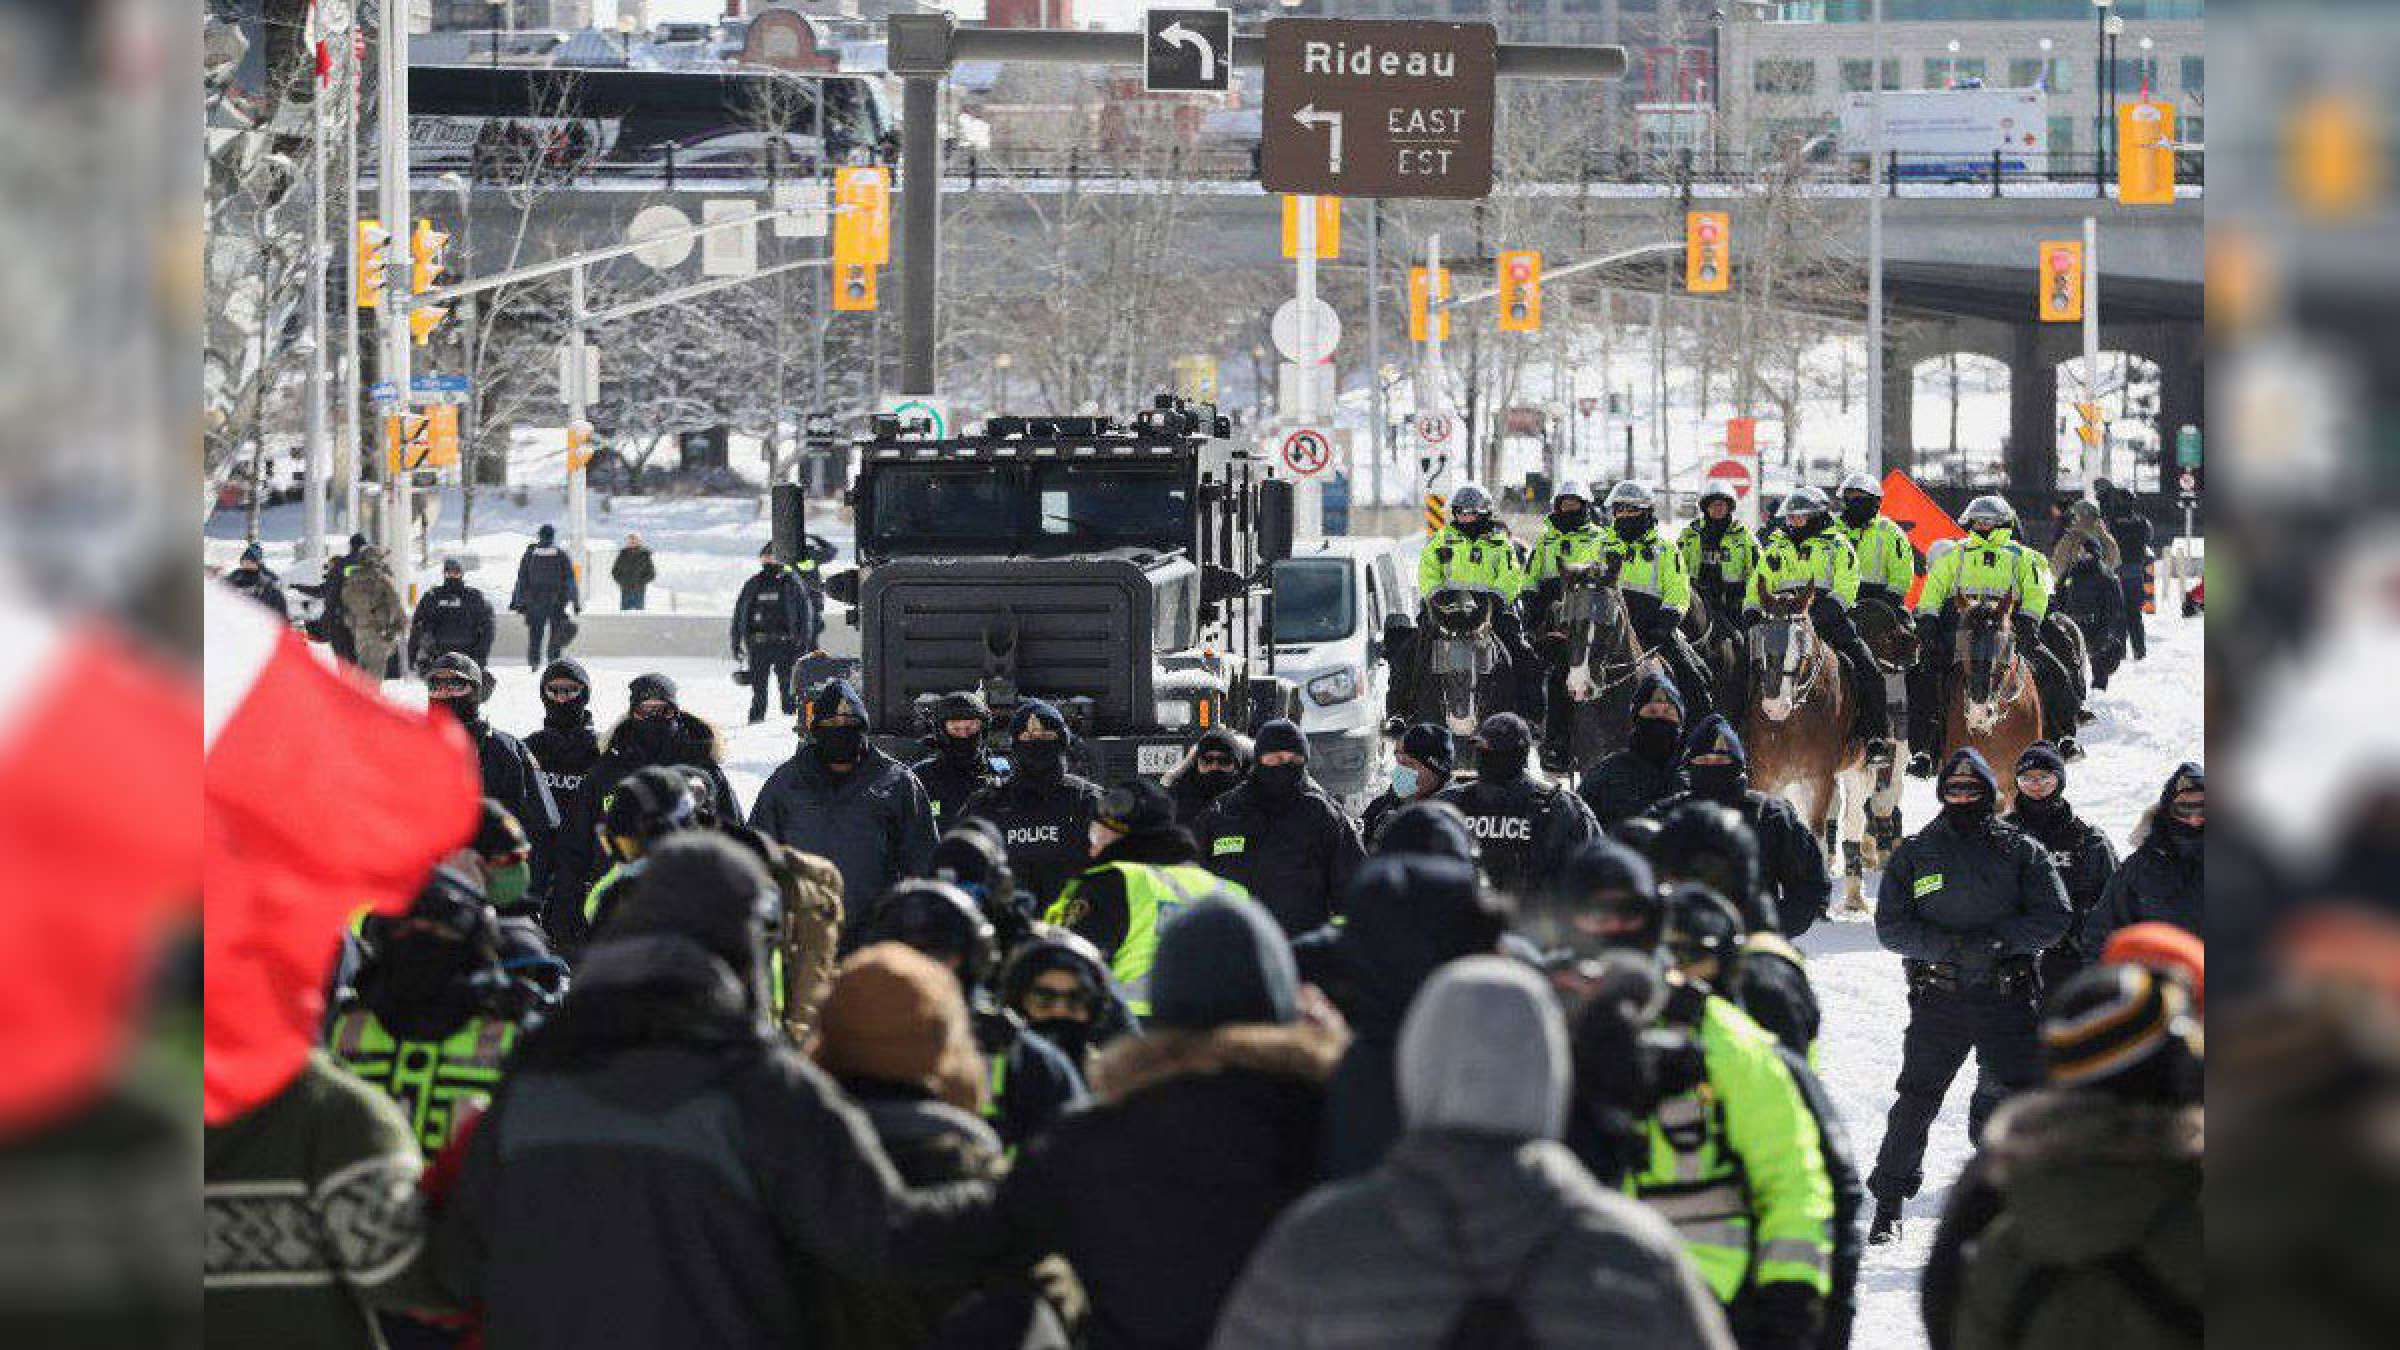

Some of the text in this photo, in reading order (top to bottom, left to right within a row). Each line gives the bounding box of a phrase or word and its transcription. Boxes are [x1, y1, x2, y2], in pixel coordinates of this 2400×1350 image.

[1304, 42, 1455, 76] Rideau
[1388, 107, 1464, 132] EAST
[1400, 150, 1452, 174] EST
[1007, 826, 1059, 844] POLICE
[1463, 816, 1531, 840] POLICE
